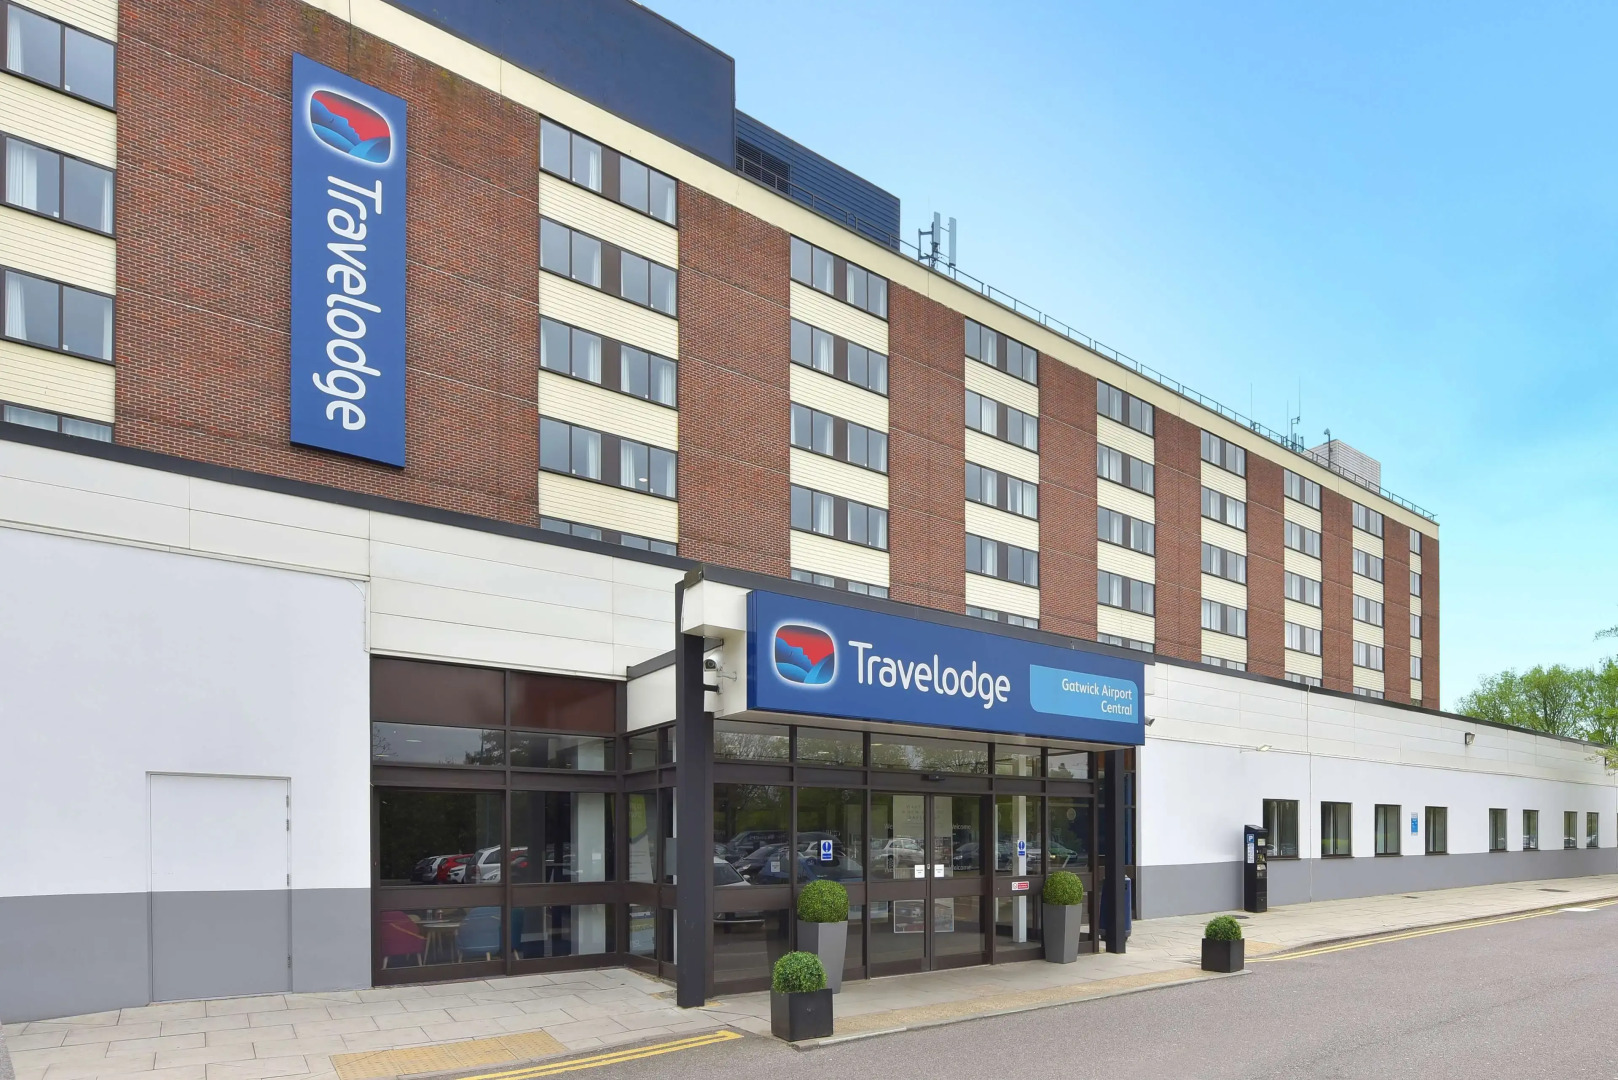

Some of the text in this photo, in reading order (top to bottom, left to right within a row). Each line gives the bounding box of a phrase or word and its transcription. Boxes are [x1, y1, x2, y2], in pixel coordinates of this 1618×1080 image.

[312, 175, 382, 431] Travelodge
[848, 640, 1011, 709] Travelodge
[1061, 678, 1133, 701] Gatwick Airport
[1101, 700, 1133, 716] Central
